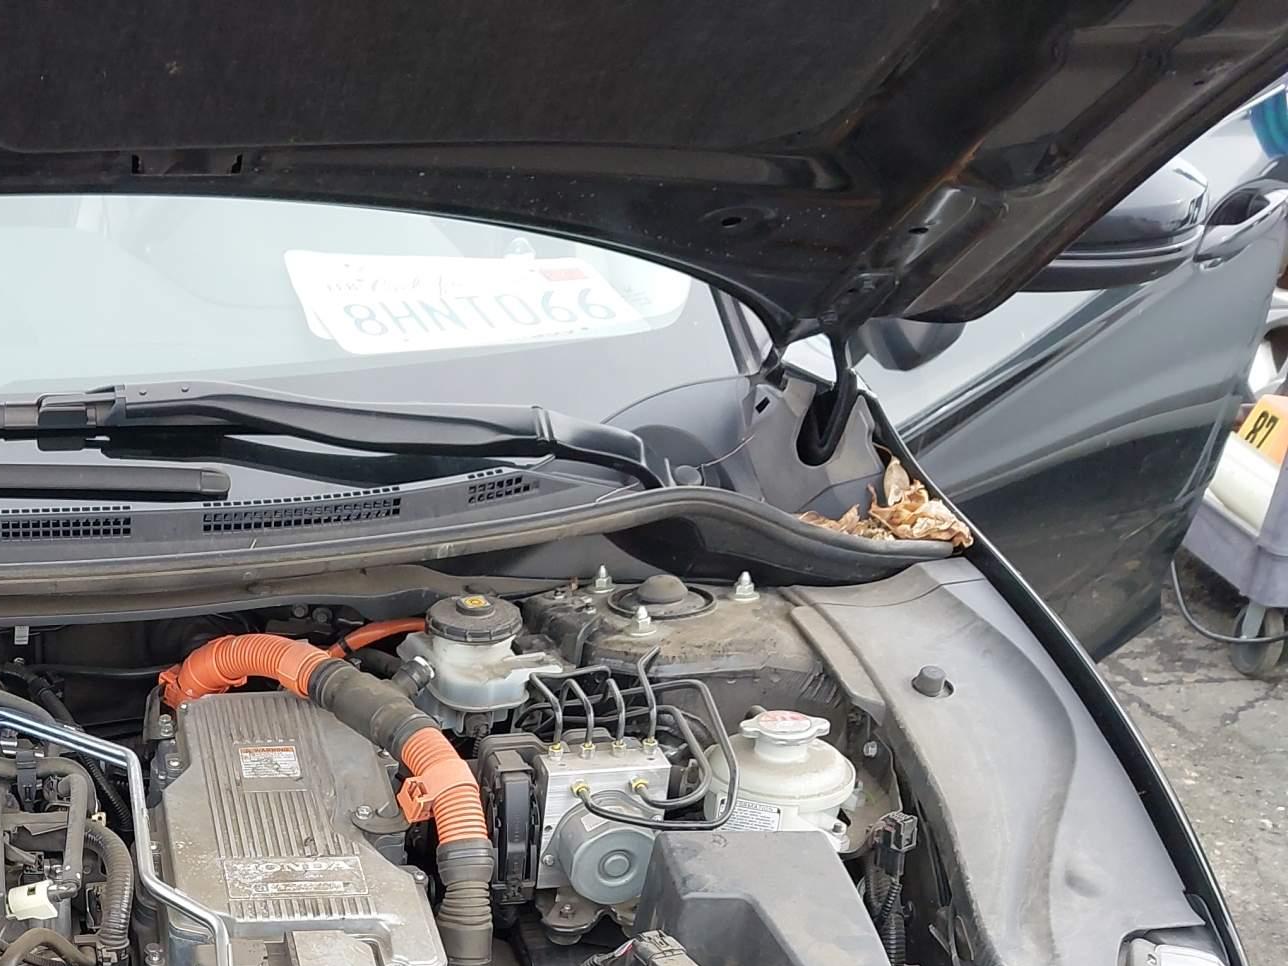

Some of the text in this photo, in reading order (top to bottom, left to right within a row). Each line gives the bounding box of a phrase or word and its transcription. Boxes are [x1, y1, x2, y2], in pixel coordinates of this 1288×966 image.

[344, 287, 617, 338] 8HNT066
[1245, 411, 1279, 449] 87
[233, 860, 355, 874] HONDA
